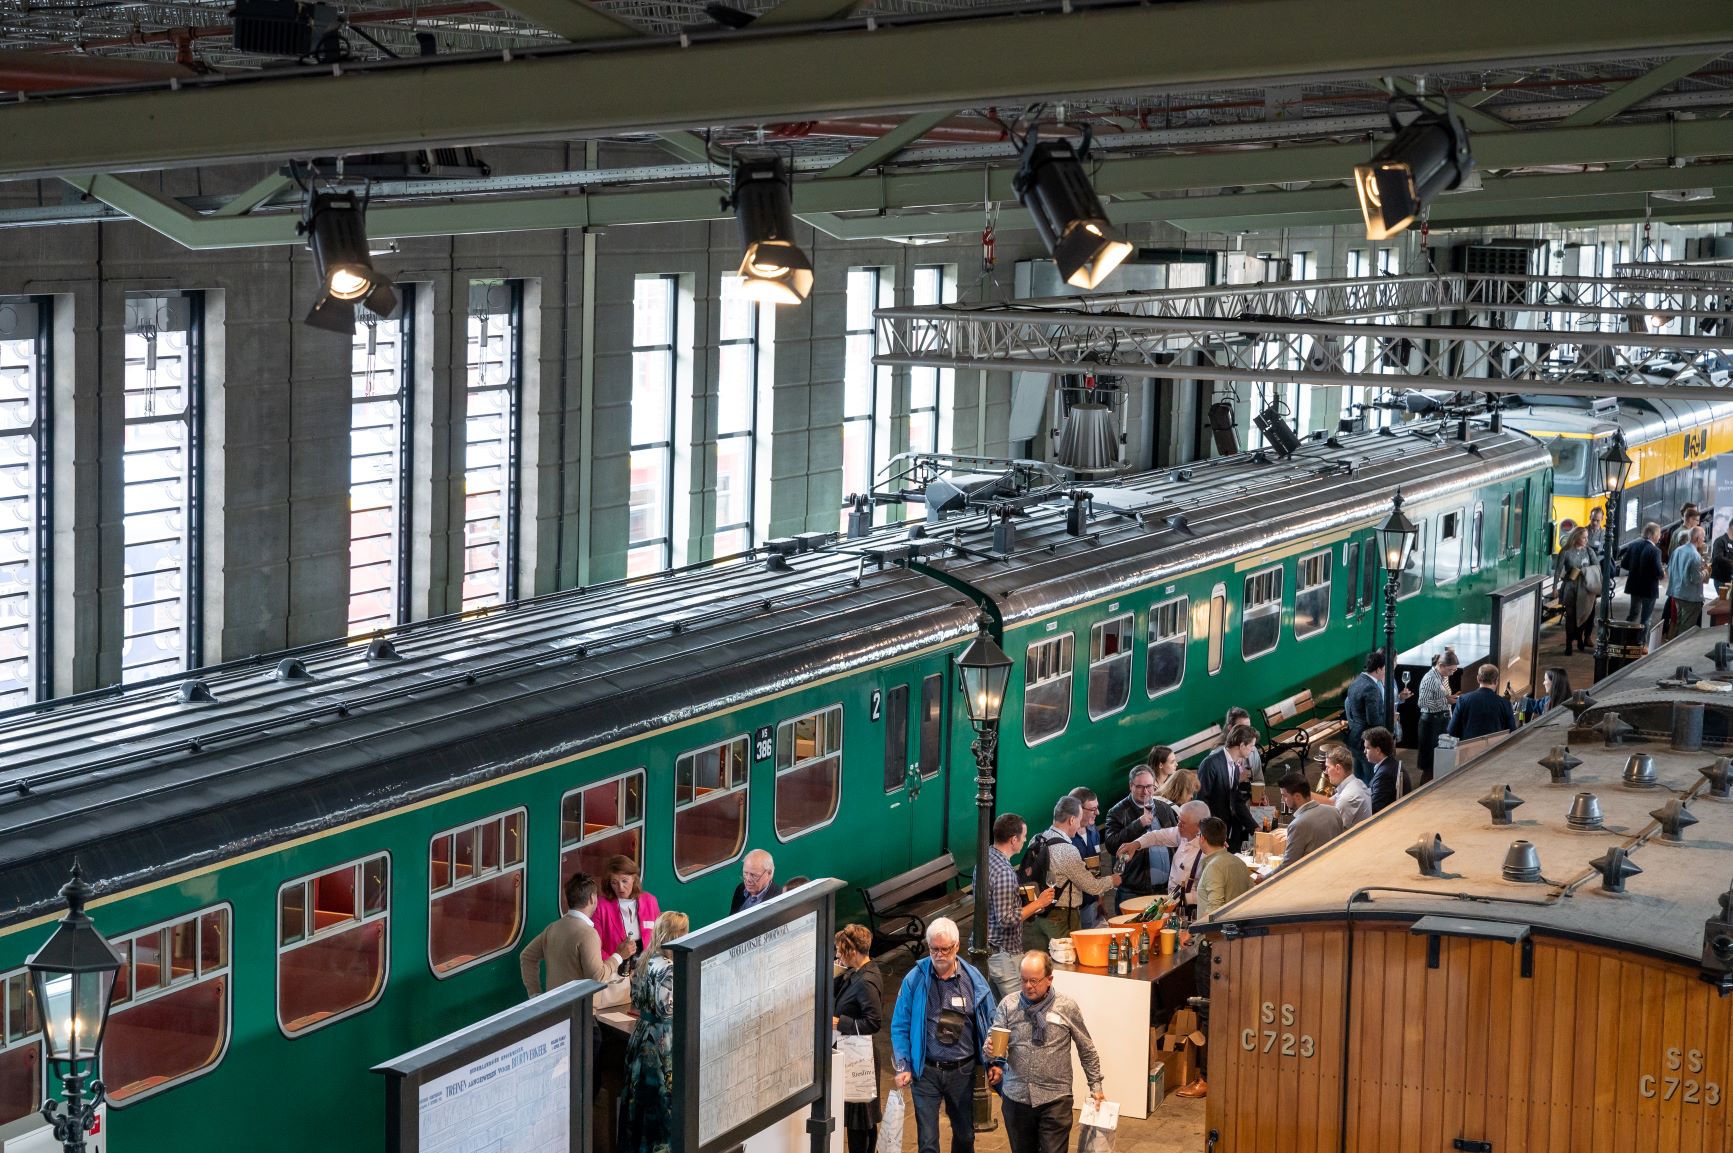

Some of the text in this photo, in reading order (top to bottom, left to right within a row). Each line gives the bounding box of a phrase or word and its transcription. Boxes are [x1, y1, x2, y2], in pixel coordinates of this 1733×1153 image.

[873, 692, 880, 720] 2
[761, 728, 768, 738] NS
[756, 738, 772, 760] 386
[1261, 1001, 1295, 1026] SS
[1666, 1047, 1703, 1073] SS
